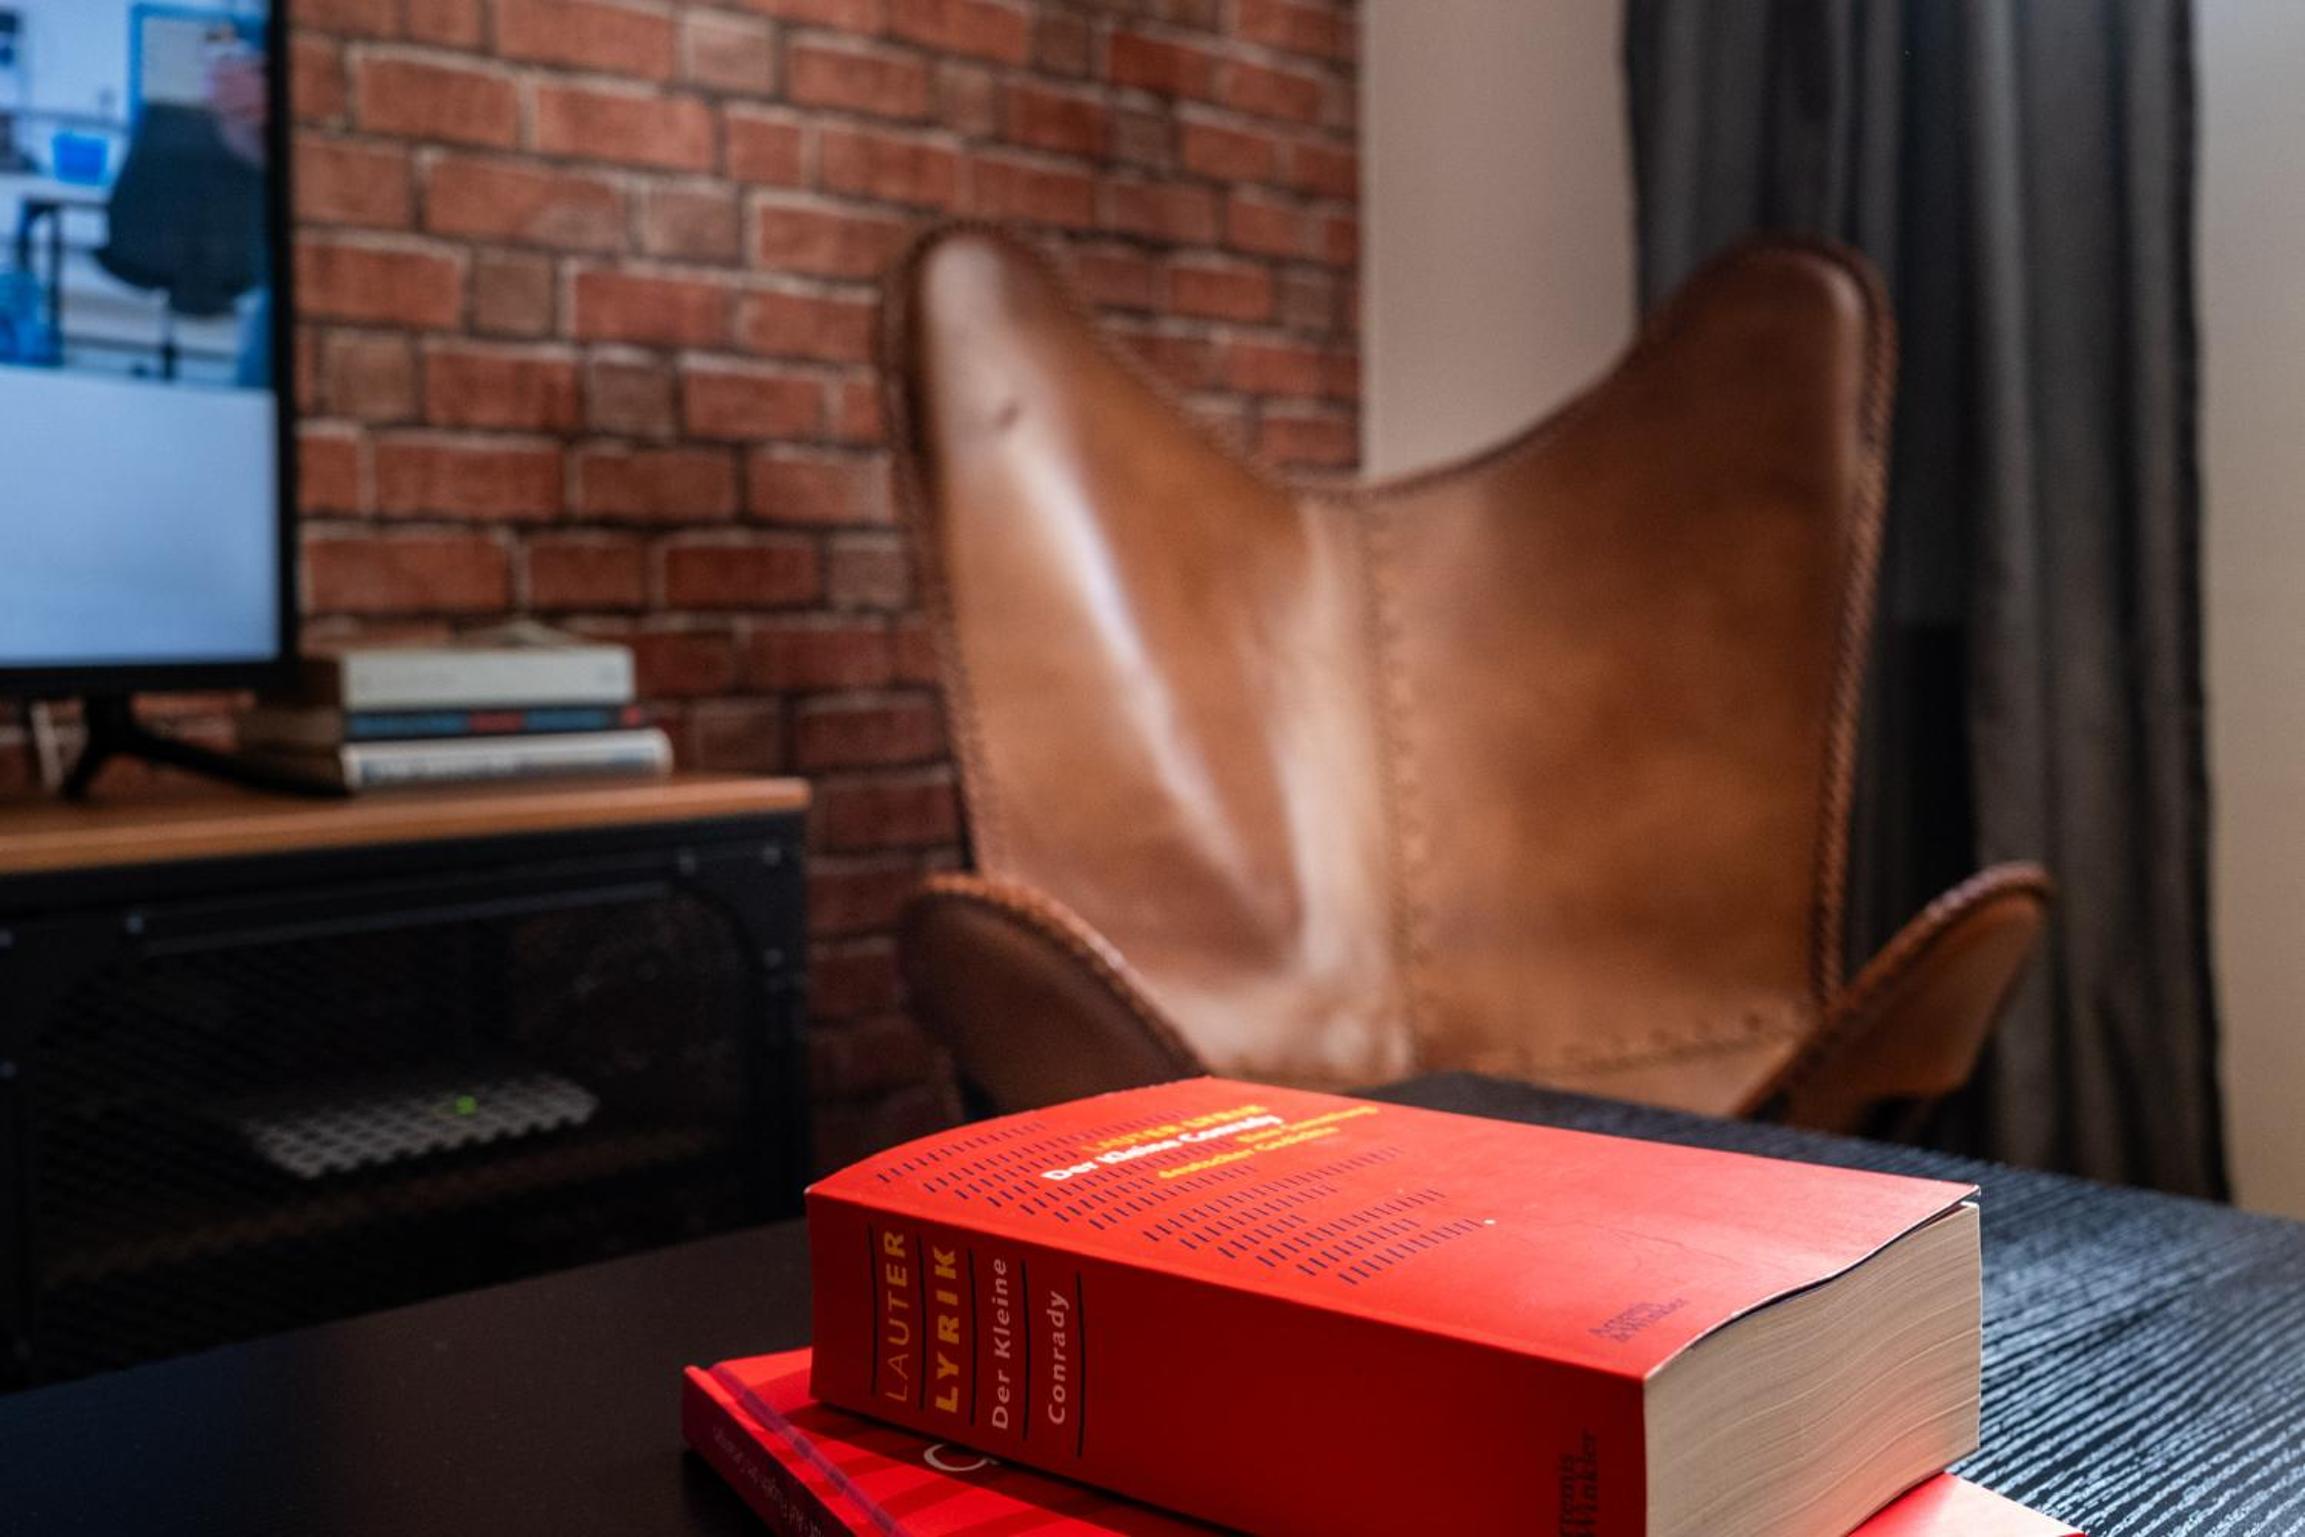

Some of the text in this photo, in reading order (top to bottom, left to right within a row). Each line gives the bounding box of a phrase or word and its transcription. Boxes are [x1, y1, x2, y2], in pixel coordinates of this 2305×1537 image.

[1040, 1114, 1285, 1180] Der Kleine Conrady
[883, 1231, 910, 1402] LAUTER
[933, 1245, 960, 1413] LYRIK
[991, 1258, 1012, 1430] Der Kleine
[1046, 1290, 1070, 1425] Conrady
